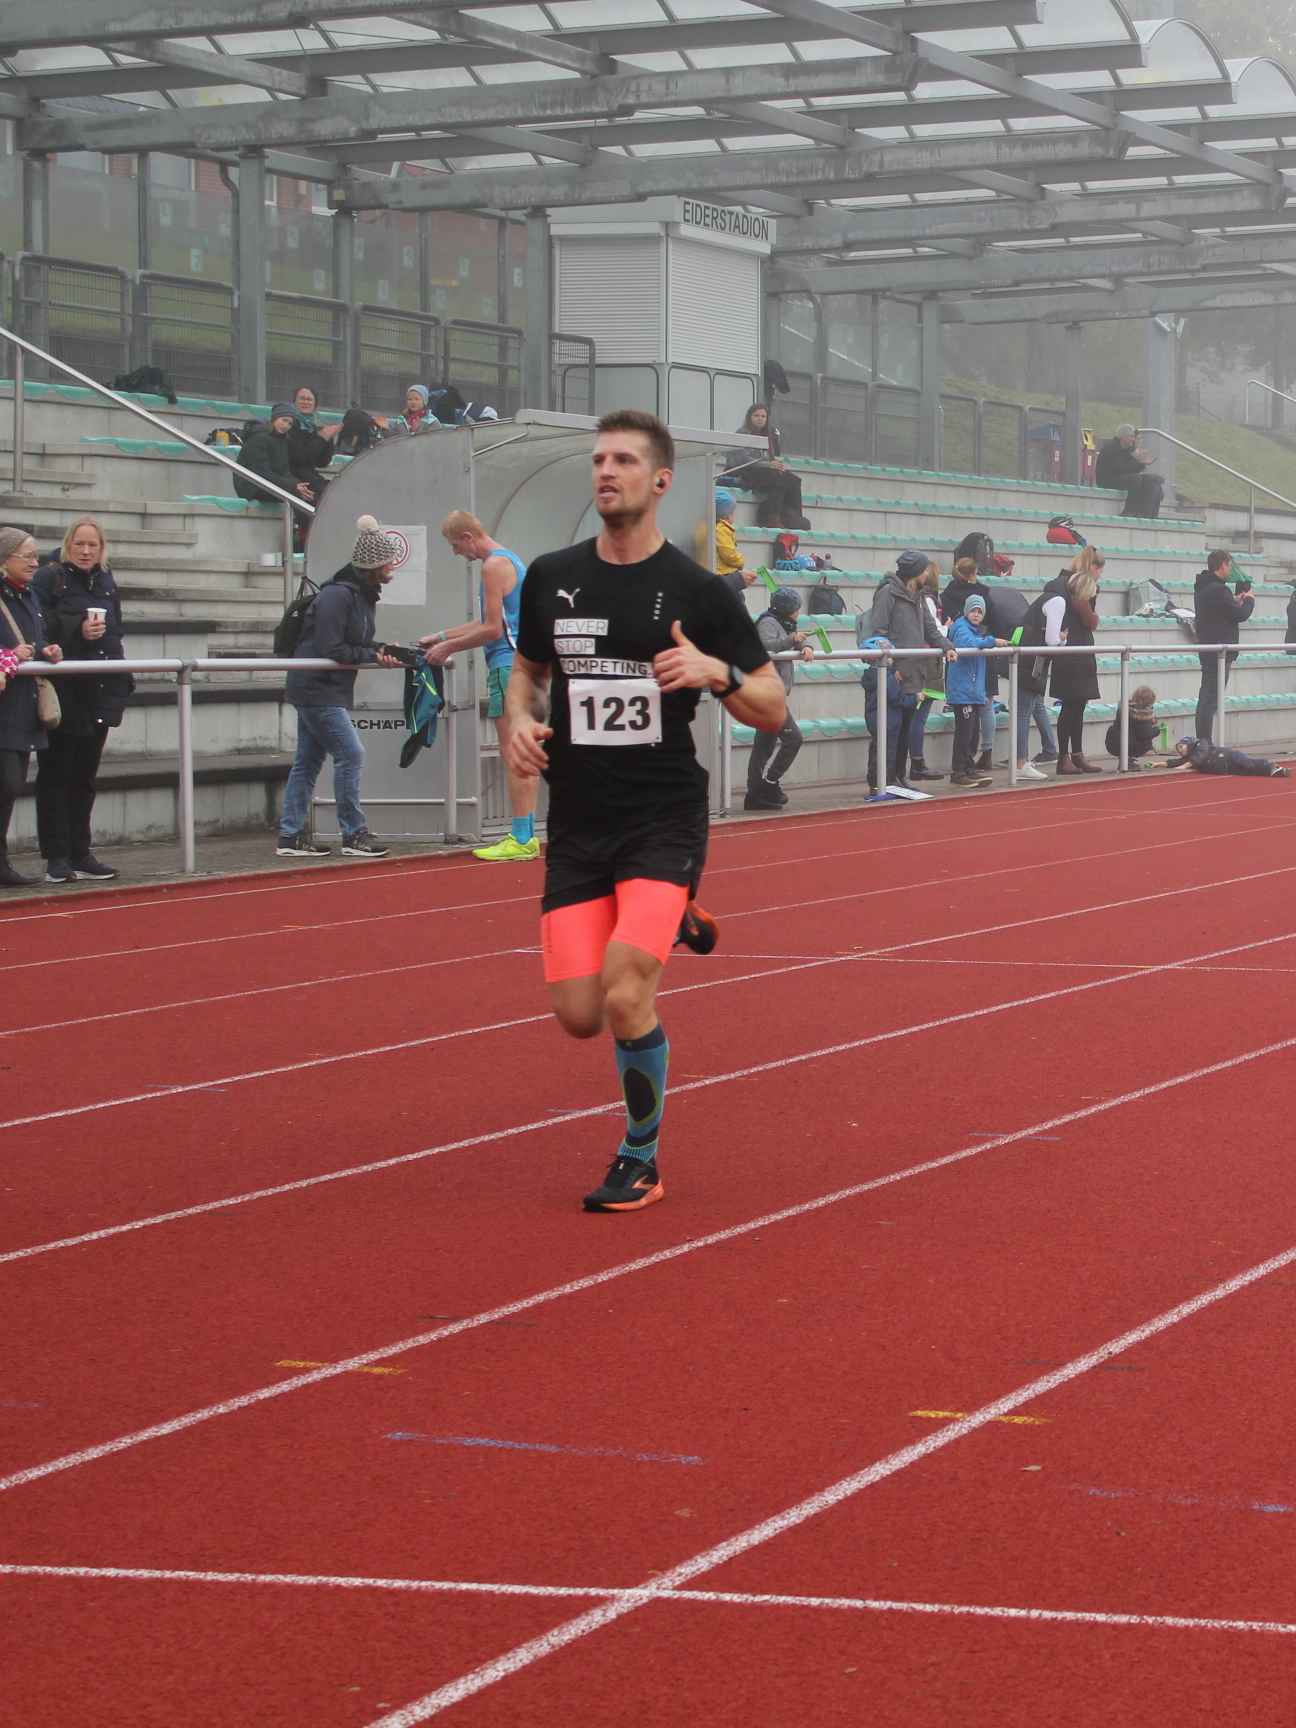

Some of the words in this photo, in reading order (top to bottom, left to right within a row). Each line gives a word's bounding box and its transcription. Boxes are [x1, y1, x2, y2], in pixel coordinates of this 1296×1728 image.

[682, 200, 769, 241] EIDERSTADION
[555, 620, 606, 634] NEVER
[557, 639, 594, 653] STOP
[579, 696, 652, 732] 123
